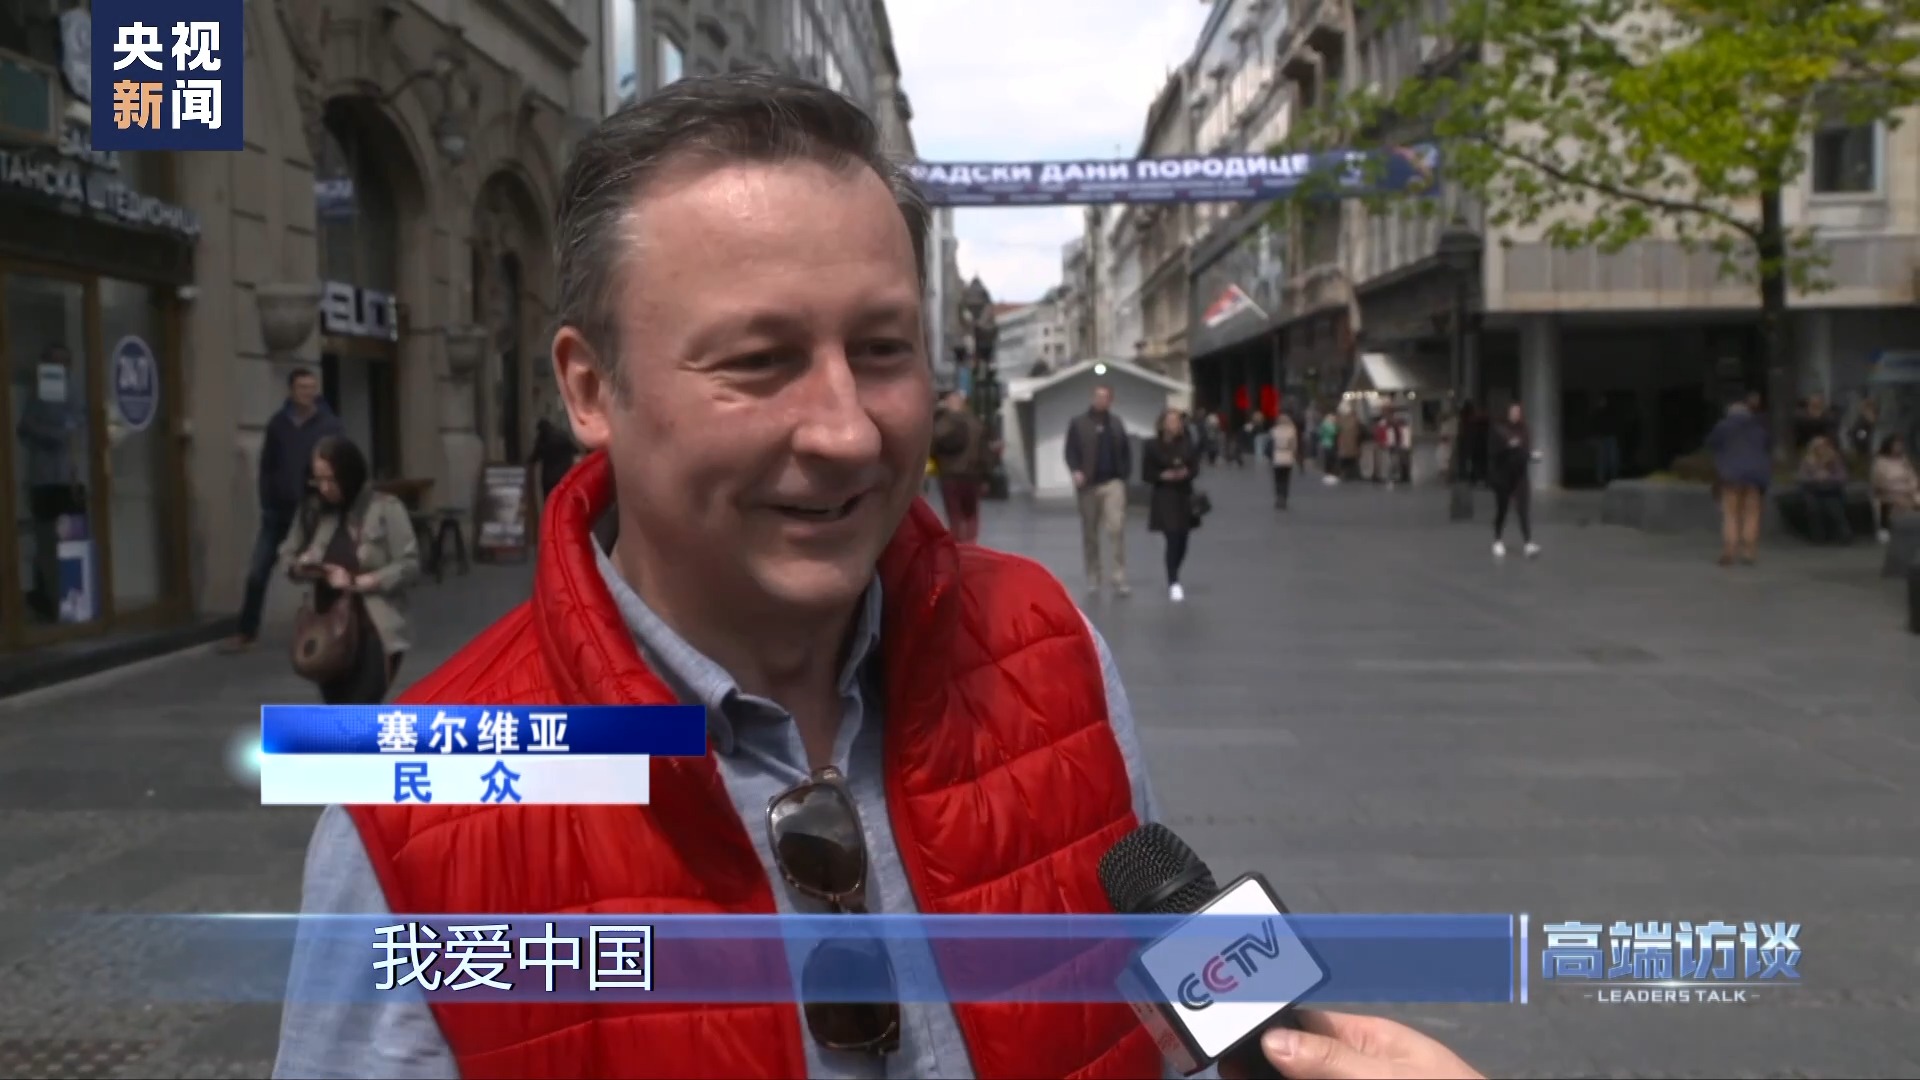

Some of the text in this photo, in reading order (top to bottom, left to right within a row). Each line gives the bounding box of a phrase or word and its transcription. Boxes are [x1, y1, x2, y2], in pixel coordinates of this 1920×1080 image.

[1039, 161, 1129, 185] ДАНИ
[1136, 153, 1310, 180] ПОРОДИЦЕ
[1177, 917, 1280, 1012] CCTV
